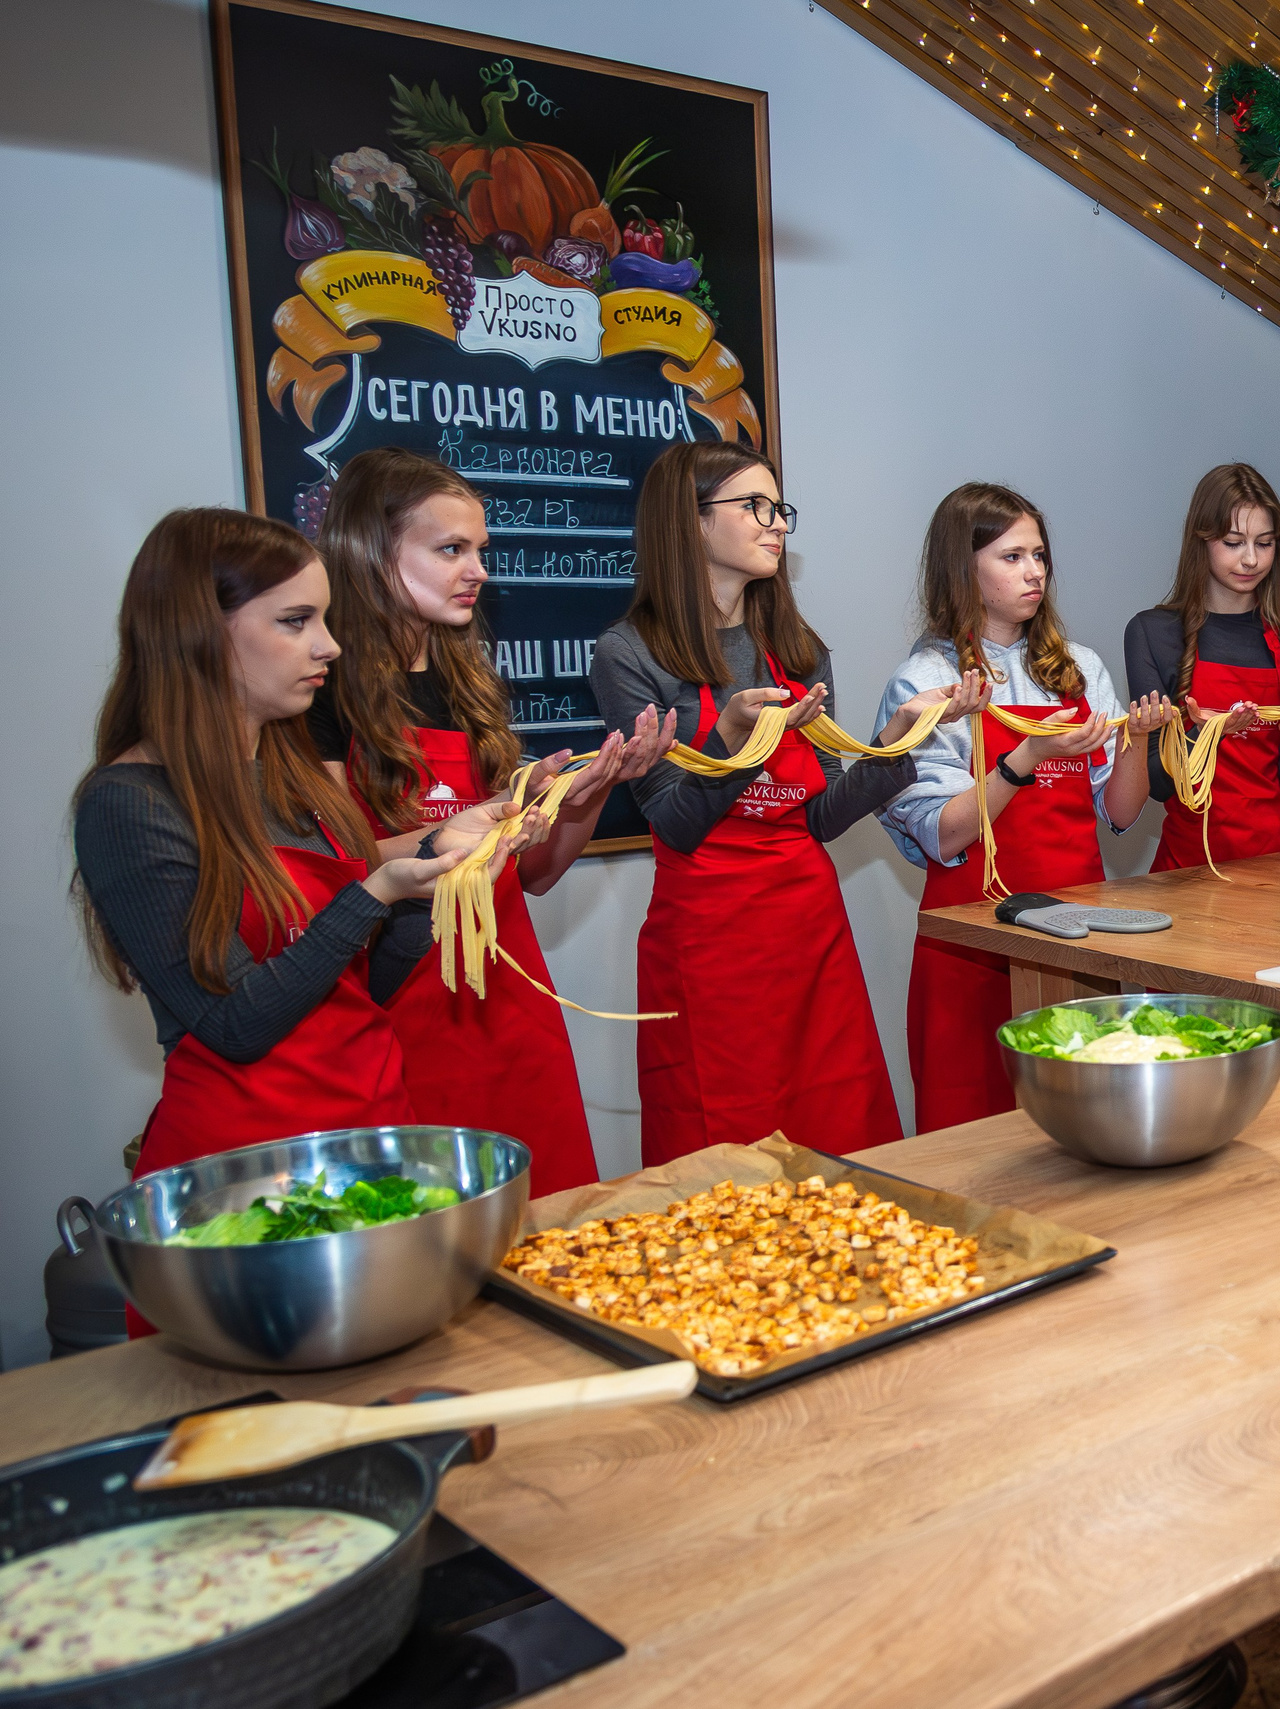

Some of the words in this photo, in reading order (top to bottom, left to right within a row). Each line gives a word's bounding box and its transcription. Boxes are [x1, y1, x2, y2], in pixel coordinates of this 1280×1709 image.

[321, 269, 438, 303] КУЛИНАРНАЯ
[484, 285, 575, 318] Просто
[479, 306, 577, 342] VKUSNO
[613, 305, 682, 328] СТУДИЯ
[366, 376, 527, 431] СЕГОДНЯ
[540, 390, 559, 432] В
[575, 393, 683, 441] МЕНЮ:
[479, 639, 543, 679] АШ
